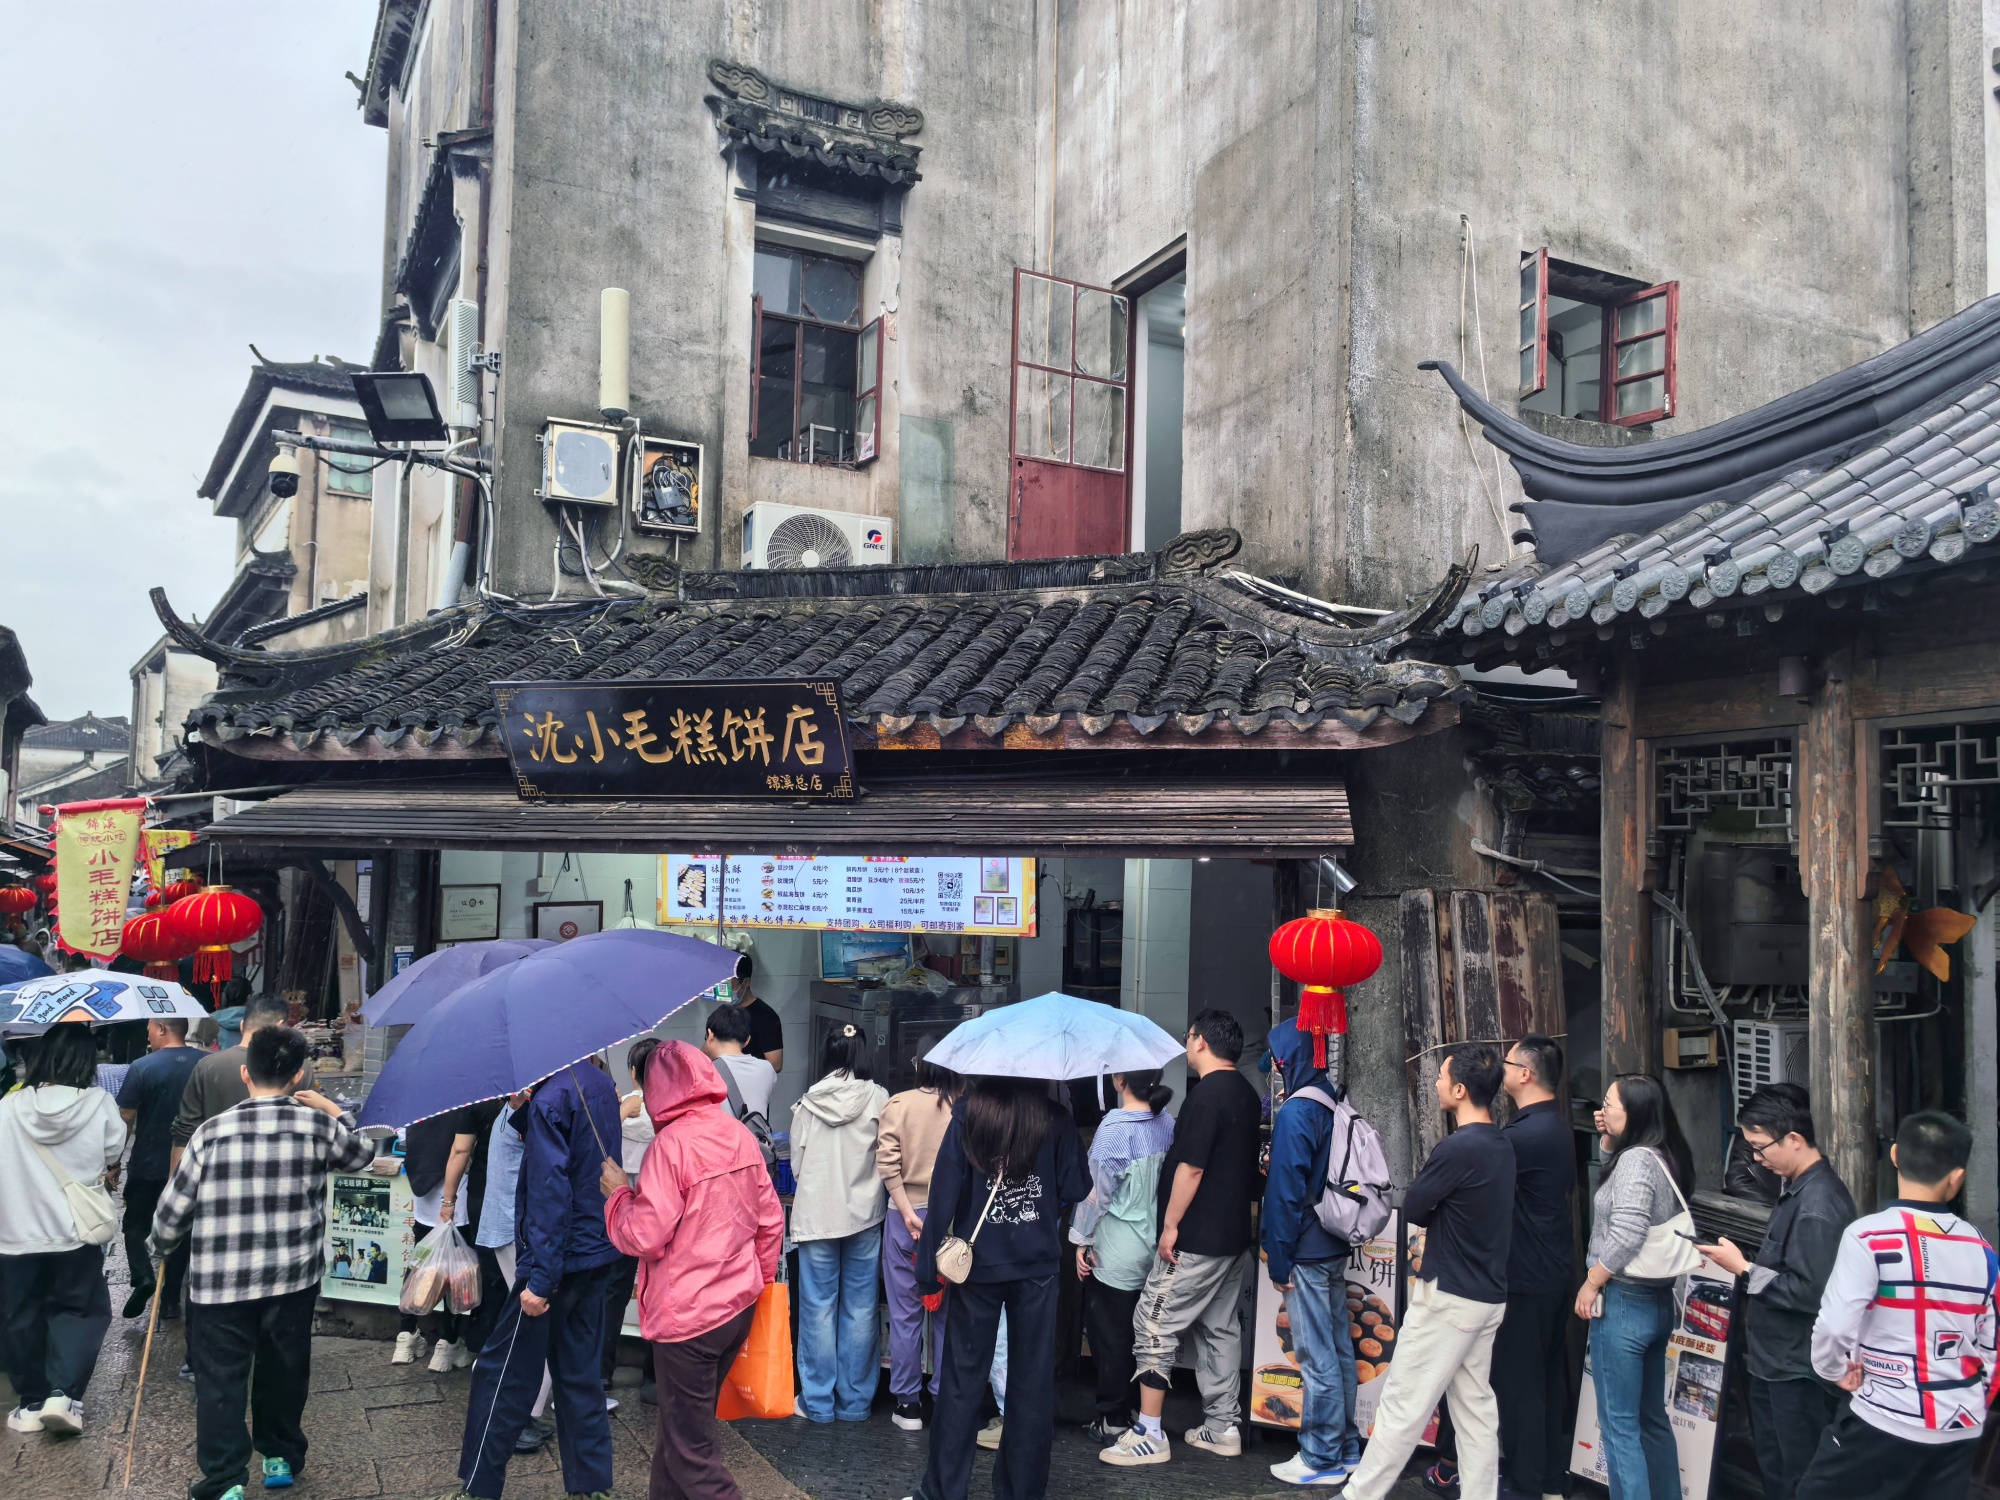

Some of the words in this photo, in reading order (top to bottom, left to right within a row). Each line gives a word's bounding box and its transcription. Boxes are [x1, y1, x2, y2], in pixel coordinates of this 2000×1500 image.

[863, 542, 886, 551] GREE
[522, 704, 826, 767] 沈小毛糕饼店
[766, 773, 824, 792] 锦溪总店
[711, 877, 741, 885] 16/10个
[777, 877, 794, 885] 玫瑰饼
[812, 878, 829, 886] 5元/个
[88, 848, 121, 947] 小毛糕饼店
[37, 1003, 55, 1023] good
[56, 987, 78, 1005] mood
